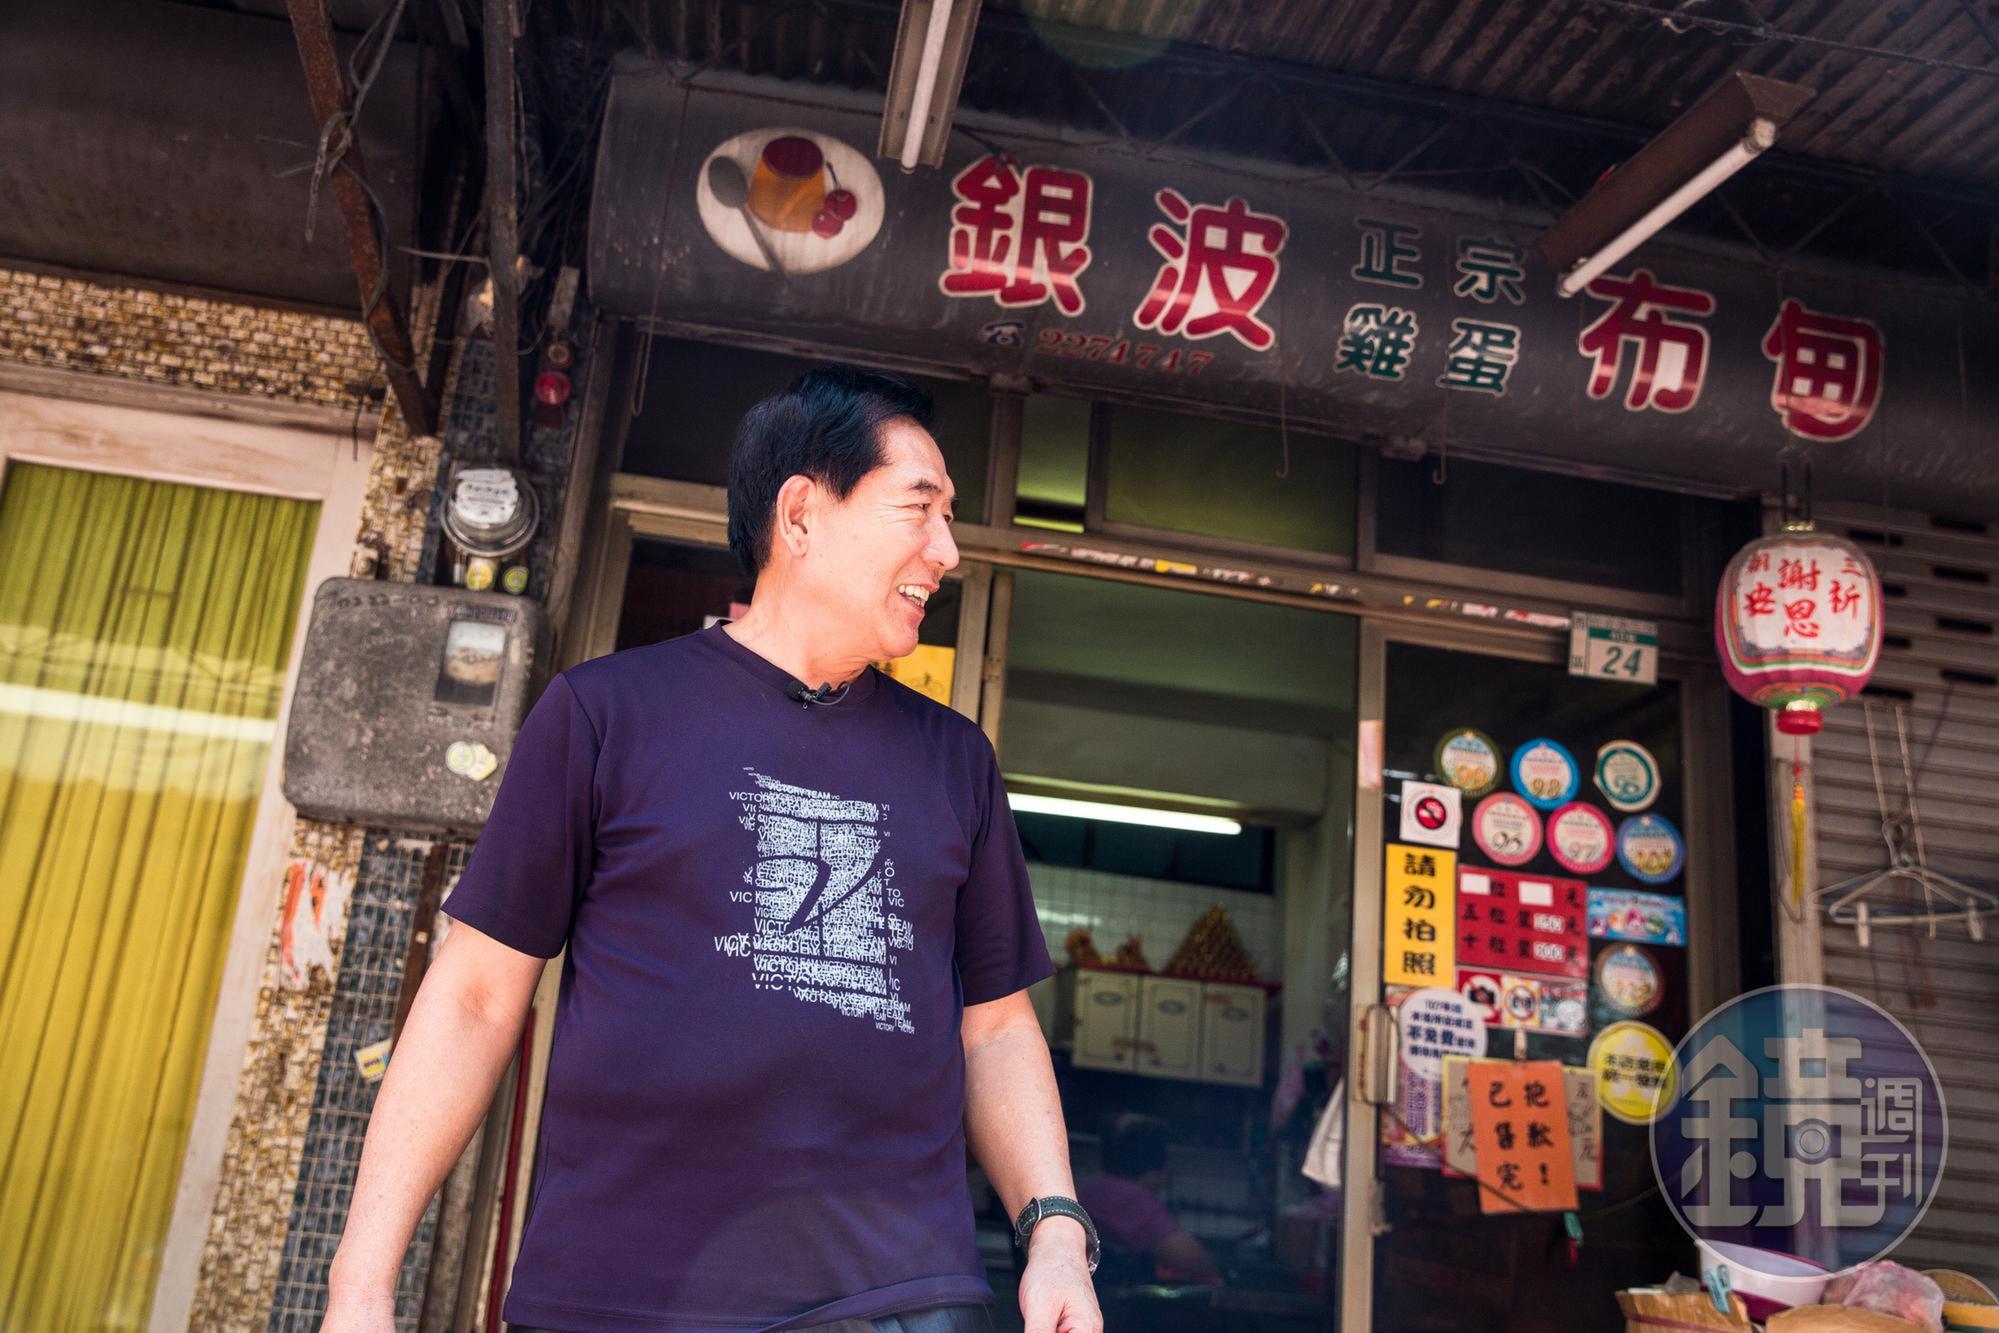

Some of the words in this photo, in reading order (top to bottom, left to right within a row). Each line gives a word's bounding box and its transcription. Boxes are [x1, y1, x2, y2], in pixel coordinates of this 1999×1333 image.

[938, 155, 1290, 351] 銀波
[1350, 217, 1527, 304] 正宗
[1036, 328, 1215, 377] 2274747
[1333, 302, 1521, 396] 雞蛋
[1578, 270, 1885, 442] 布甸
[1601, 645, 1642, 677] 24
[1403, 852, 1436, 977] 請勿拍照
